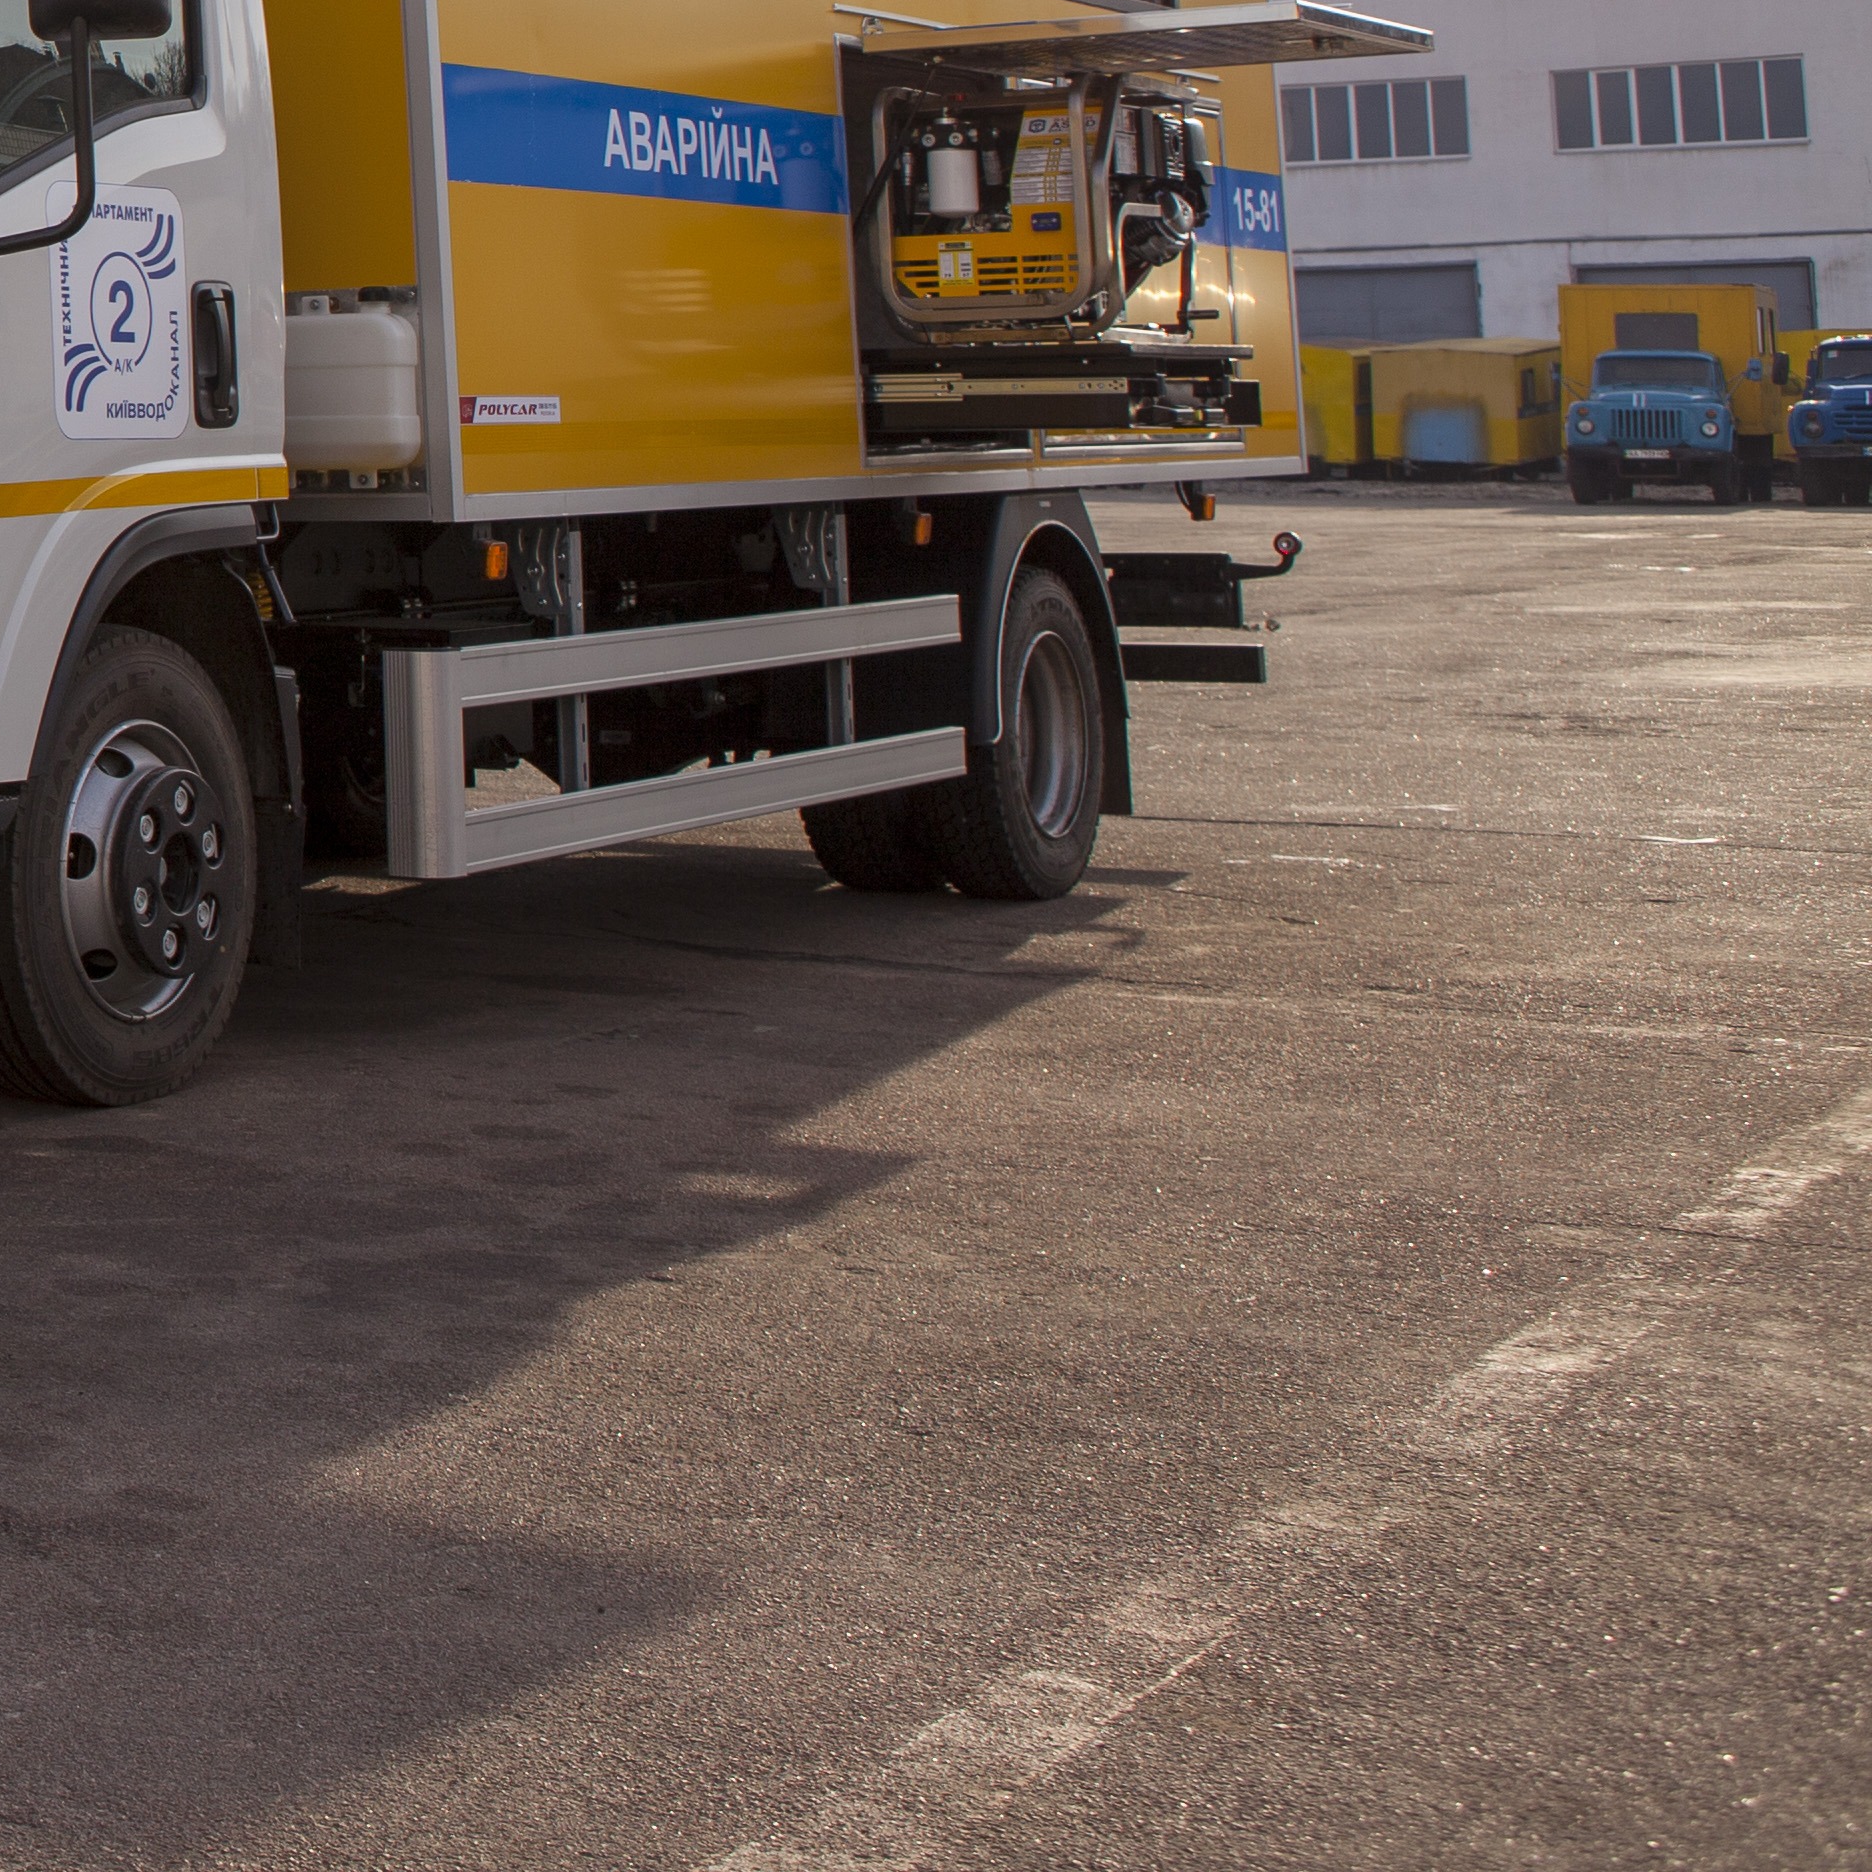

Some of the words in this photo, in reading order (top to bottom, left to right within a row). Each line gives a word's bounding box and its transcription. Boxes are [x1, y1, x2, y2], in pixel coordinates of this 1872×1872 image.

[604, 106, 779, 185] АВАРІЙНА
[1233, 186, 1280, 233] 15-81
[108, 279, 136, 343] 2
[478, 404, 537, 416] POLYCAR
